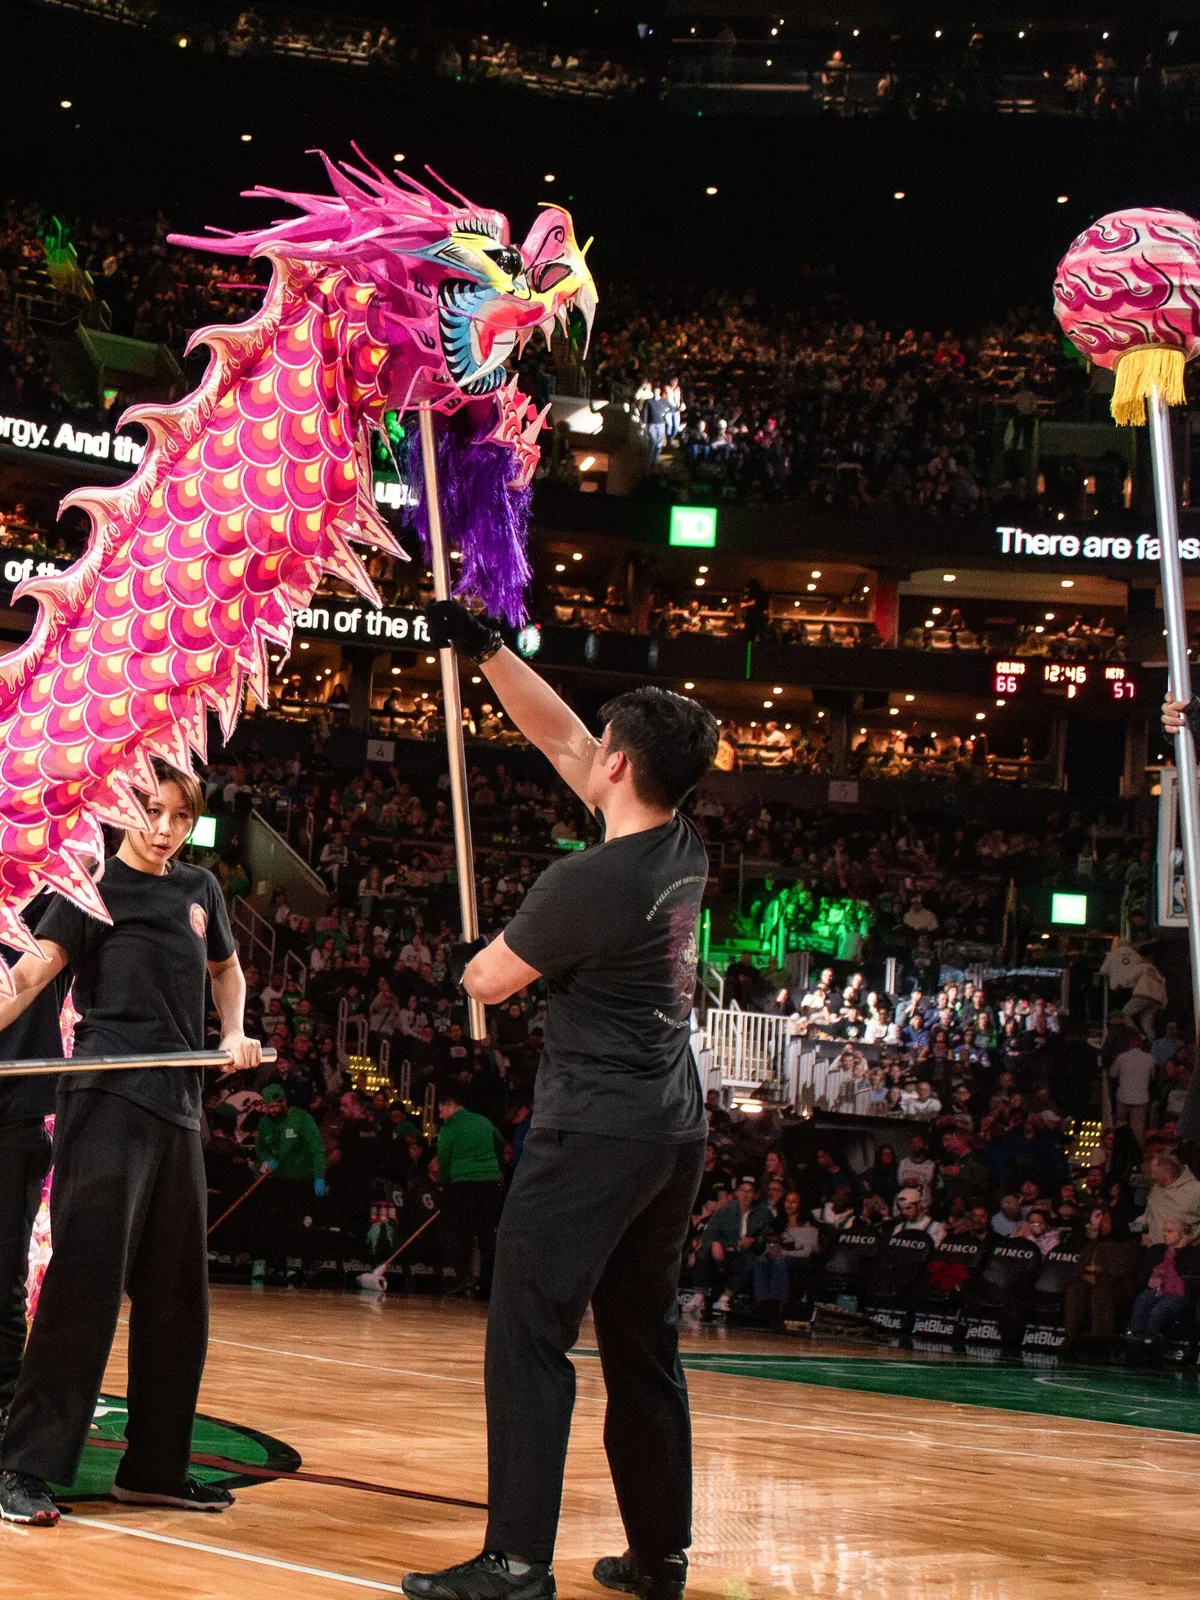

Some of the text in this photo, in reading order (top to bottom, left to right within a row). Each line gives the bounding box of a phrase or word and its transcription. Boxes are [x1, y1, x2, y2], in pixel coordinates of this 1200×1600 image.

[54, 423, 110, 458] And
[113, 435, 146, 465] th
[675, 513, 714, 539] TD
[996, 526, 1200, 560] There are fas
[4, 557, 34, 583] of
[334, 607, 362, 633] of
[366, 611, 408, 639] the
[1044, 665, 1087, 684] 12:46
[996, 676, 1017, 693] 66
[1113, 682, 1135, 698] 57
[839, 1234, 876, 1245] PIMCO
[889, 1238, 926, 1250] PIMCO
[939, 1242, 978, 1255] PIMCO
[993, 1247, 1034, 1260] PIMCO
[1048, 1251, 1081, 1263] PIMC
[912, 1319, 954, 1336] jetBlue
